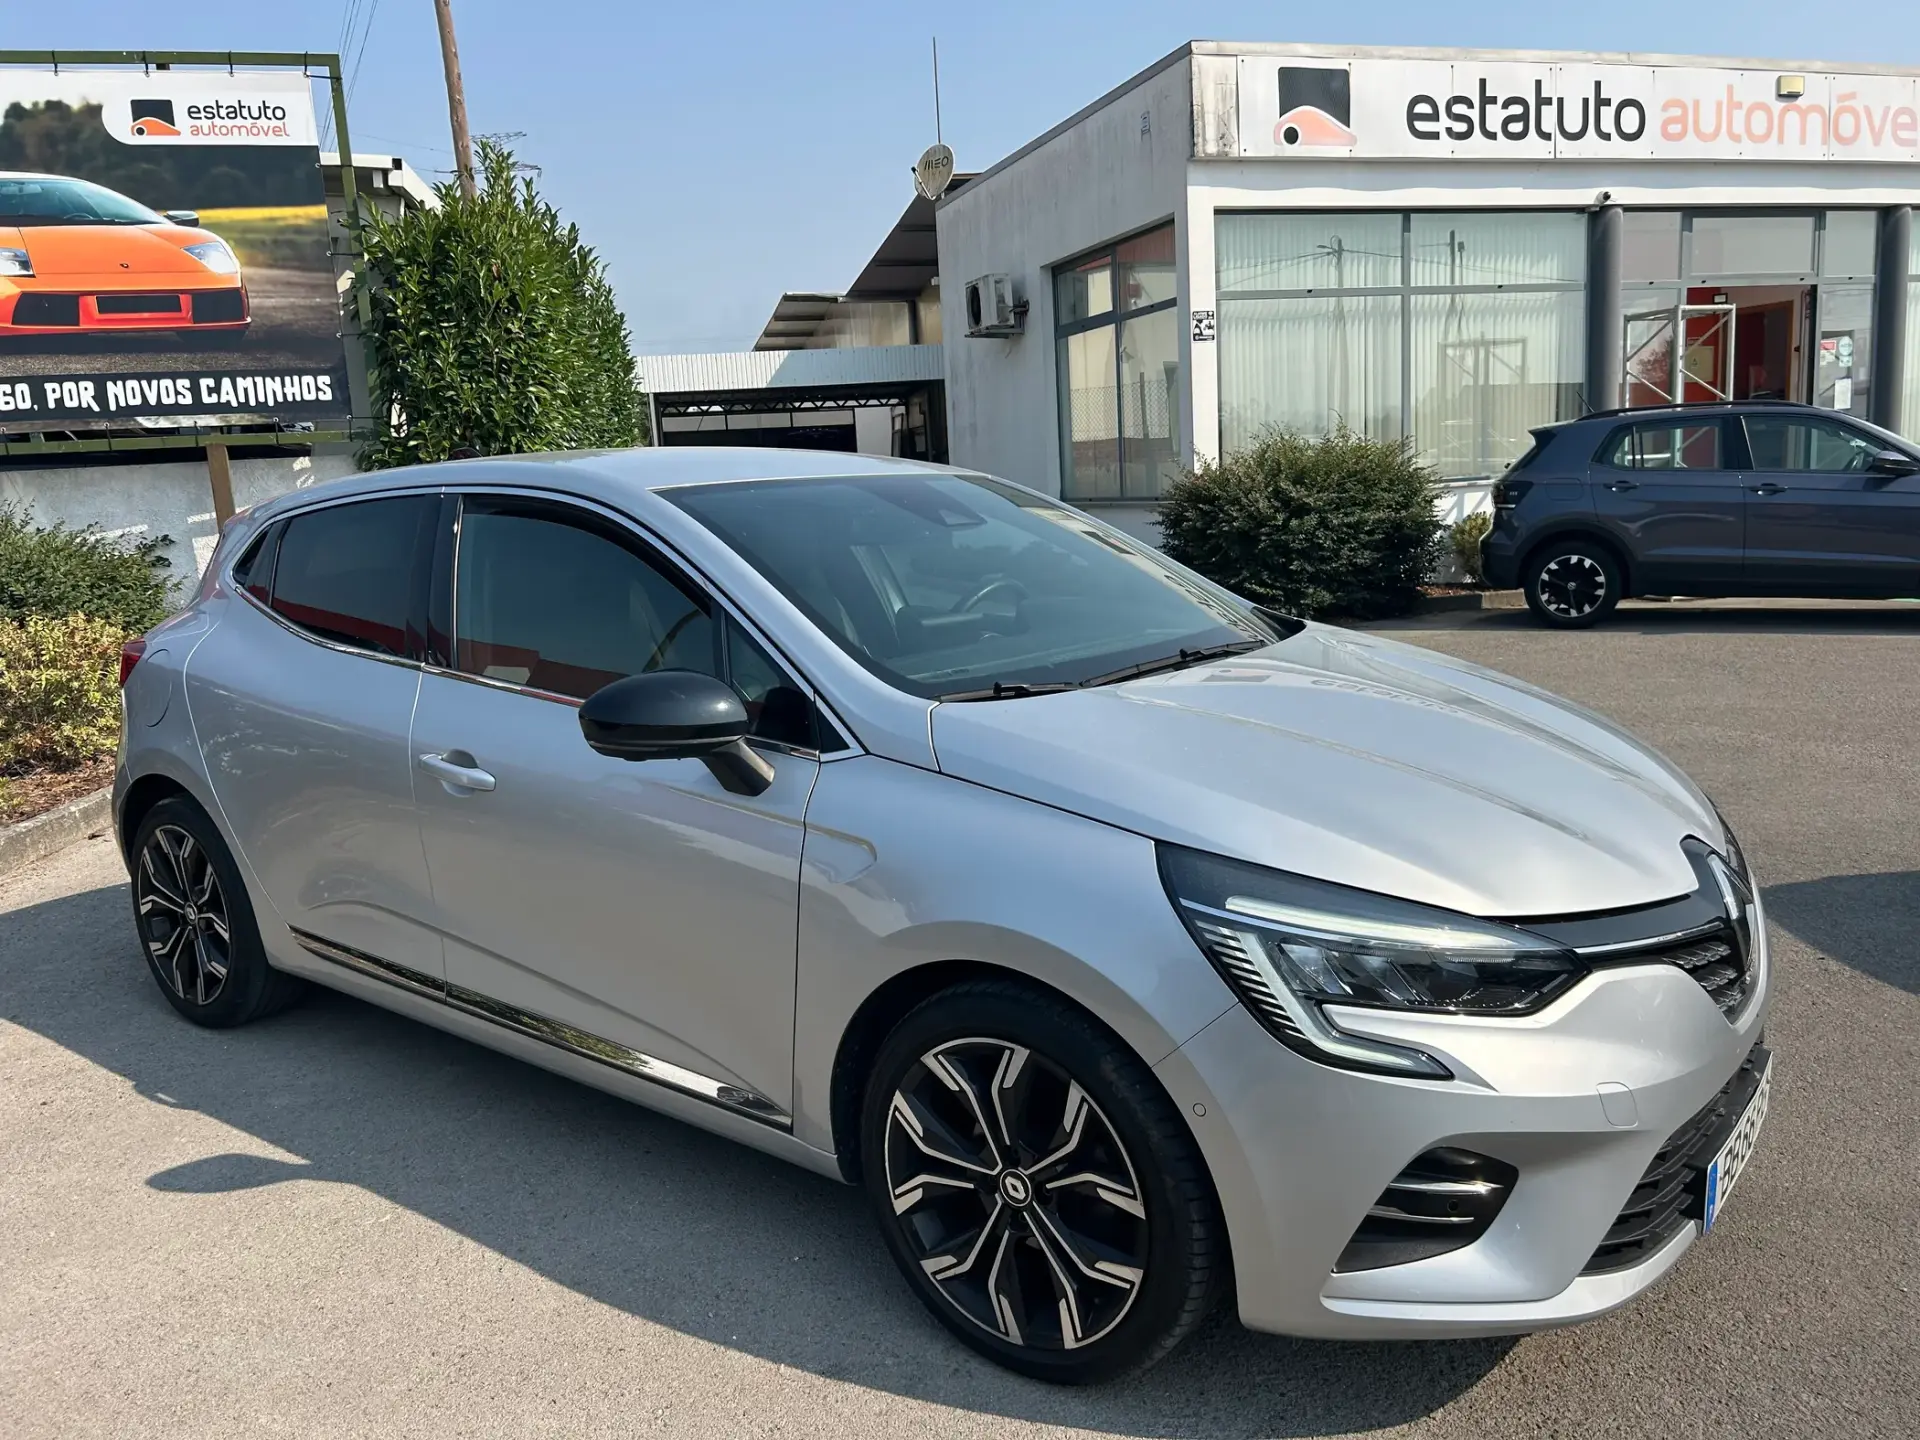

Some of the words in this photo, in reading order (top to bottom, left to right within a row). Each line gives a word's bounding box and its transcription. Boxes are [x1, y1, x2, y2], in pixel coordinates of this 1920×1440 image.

[187, 99, 286, 121] estatuto
[1406, 78, 1646, 142] estatuto
[190, 121, 290, 137] automóvel
[924, 156, 949, 171] MEO
[44, 381, 100, 412] POR
[106, 378, 193, 411] NOVOS
[199, 375, 333, 407] CAMINHOS
